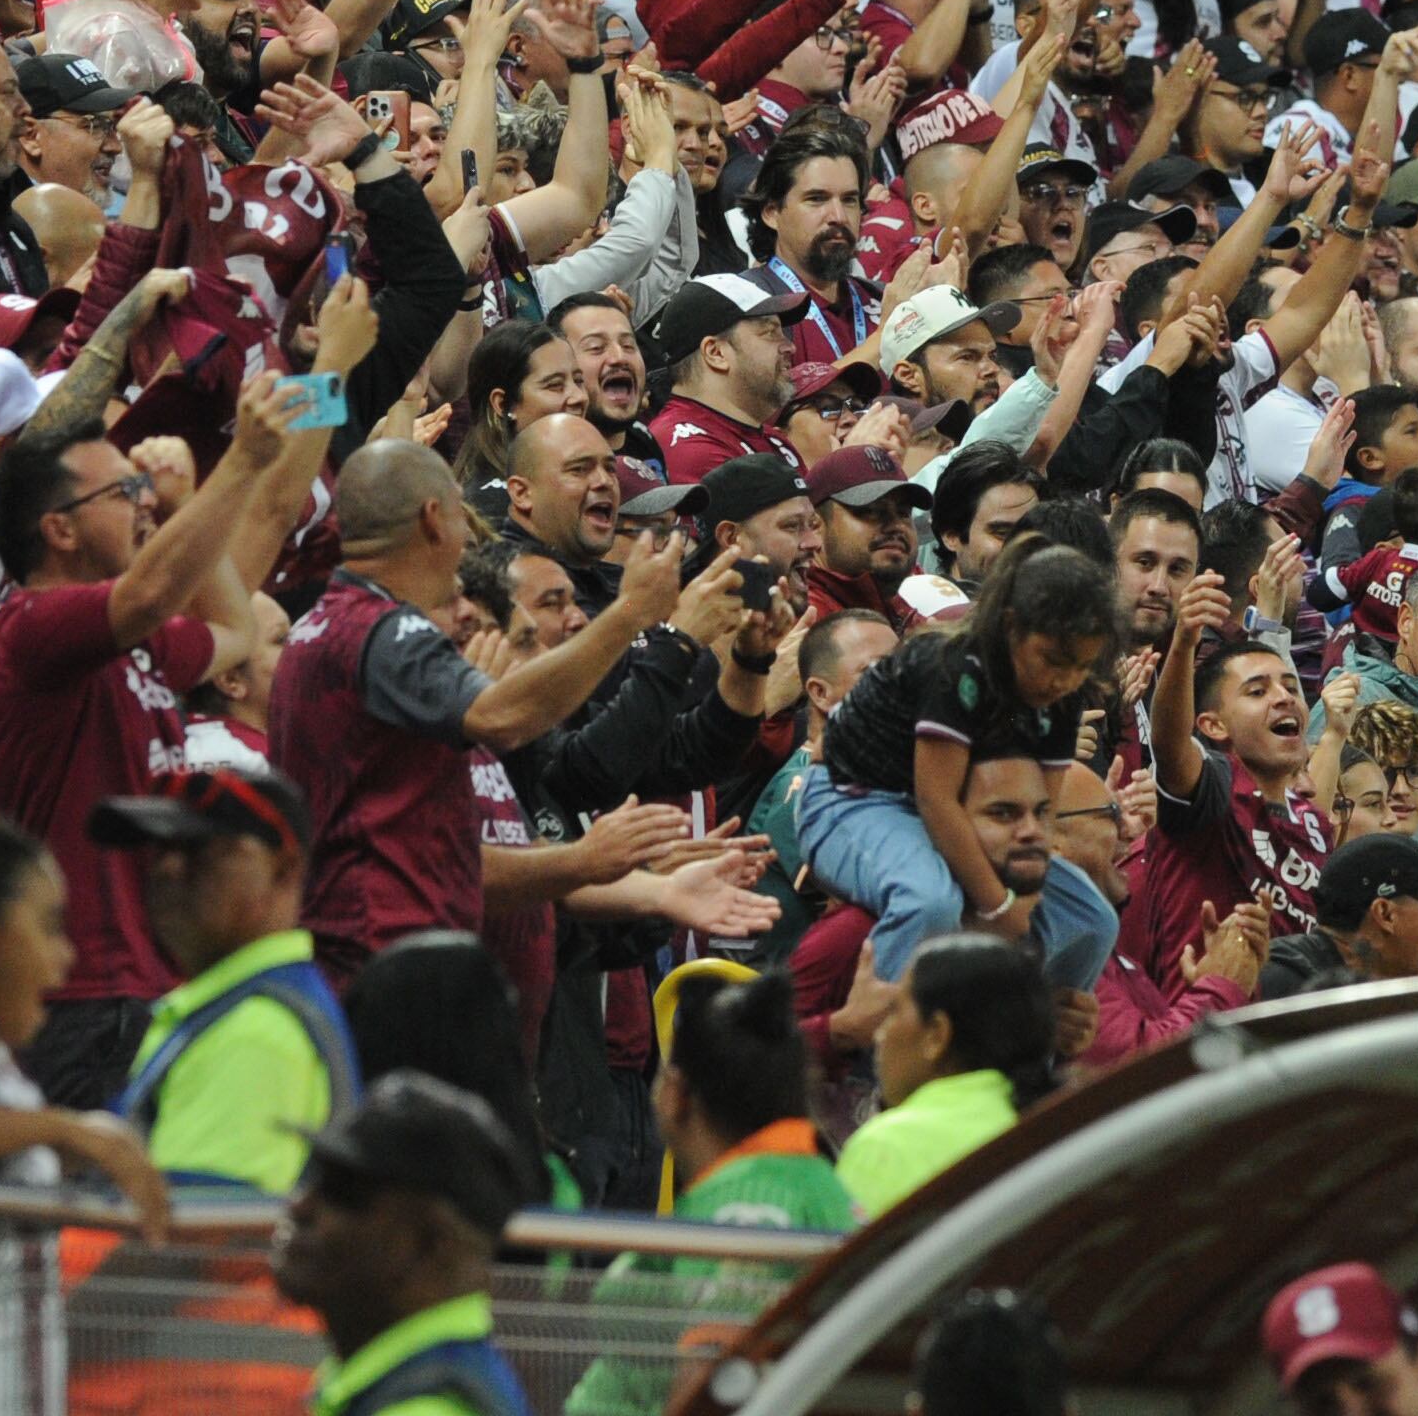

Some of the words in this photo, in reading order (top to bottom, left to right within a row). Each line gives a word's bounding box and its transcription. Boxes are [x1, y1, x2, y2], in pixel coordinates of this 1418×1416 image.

[1386, 571, 1405, 593] G
[1304, 812, 1328, 854] S
[1294, 1285, 1341, 1337] S
